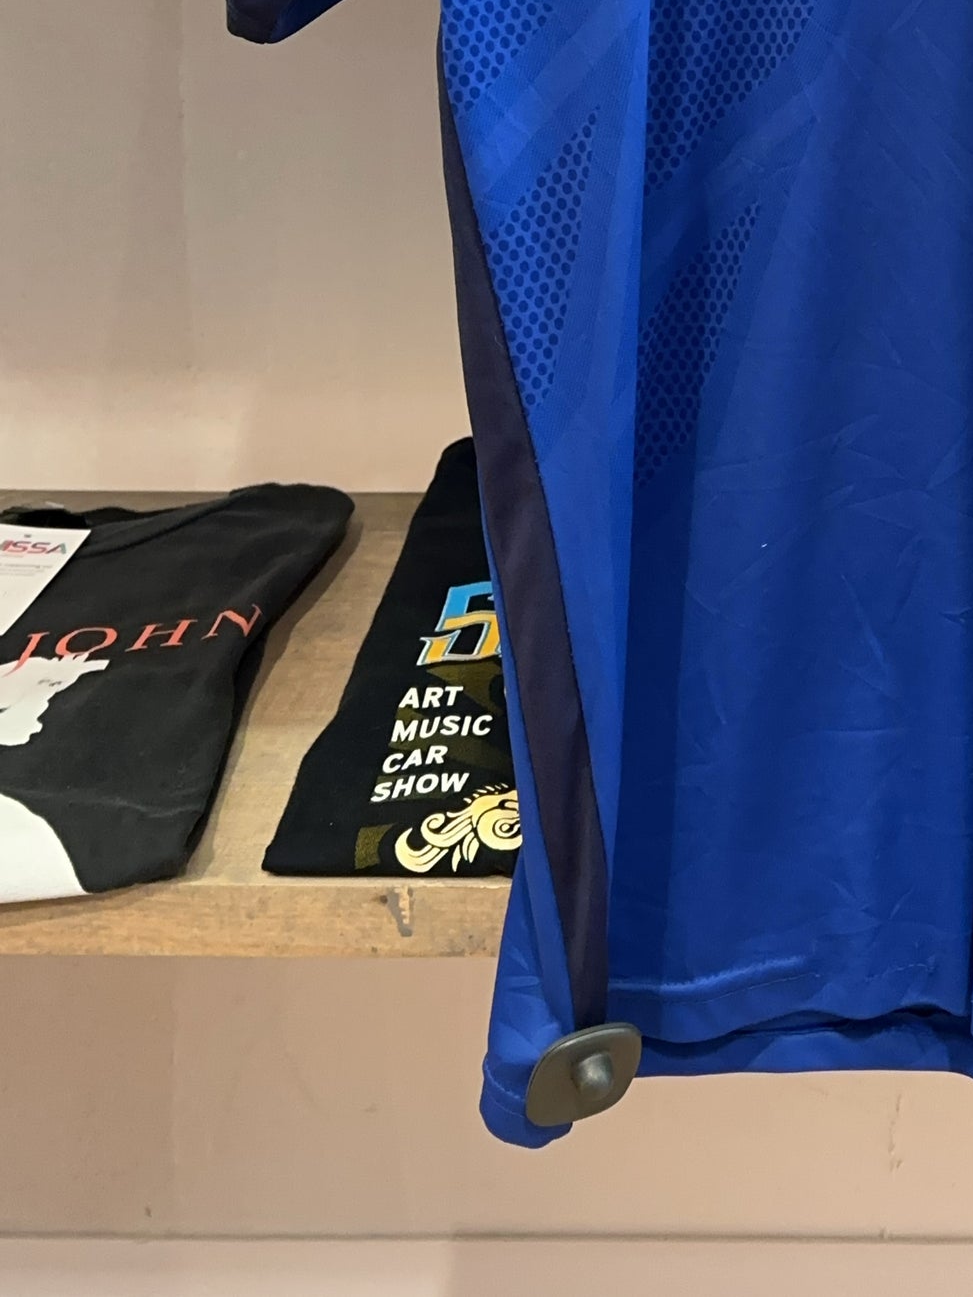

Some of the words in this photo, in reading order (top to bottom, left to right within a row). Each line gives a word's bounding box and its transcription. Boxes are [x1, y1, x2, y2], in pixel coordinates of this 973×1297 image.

[2, 603, 263, 678] JOHN
[399, 686, 463, 709] ART
[391, 715, 492, 742] MUSIC
[382, 745, 448, 774] CAR
[370, 773, 470, 802] SHOW
